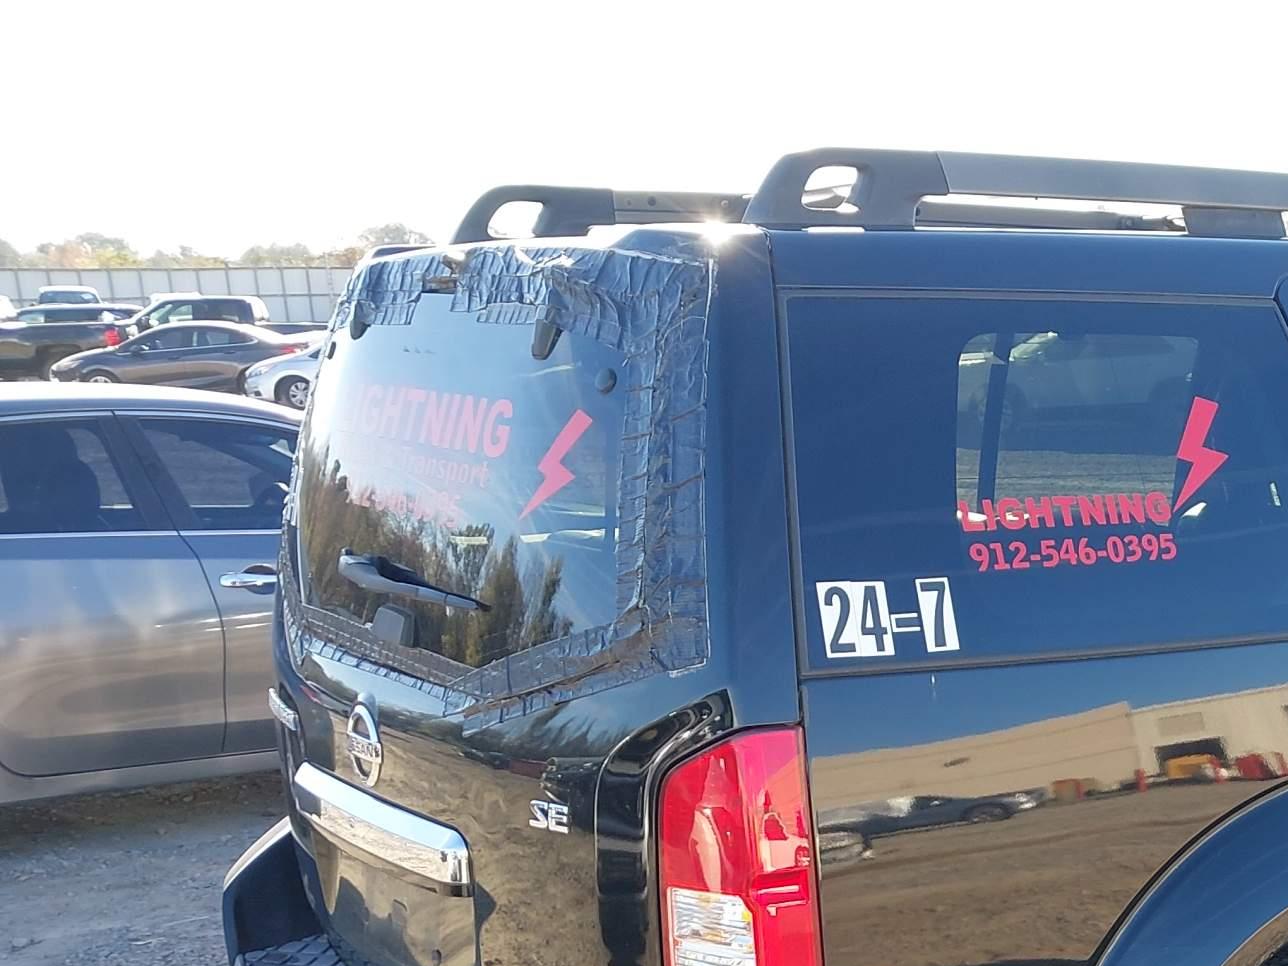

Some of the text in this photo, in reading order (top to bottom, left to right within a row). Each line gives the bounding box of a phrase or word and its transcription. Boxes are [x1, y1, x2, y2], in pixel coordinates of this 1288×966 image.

[343, 383, 513, 458] IGHTNING
[956, 491, 1172, 533] LIGHTNING
[968, 533, 1178, 573] 912-546-0395
[528, 799, 570, 835] SE
